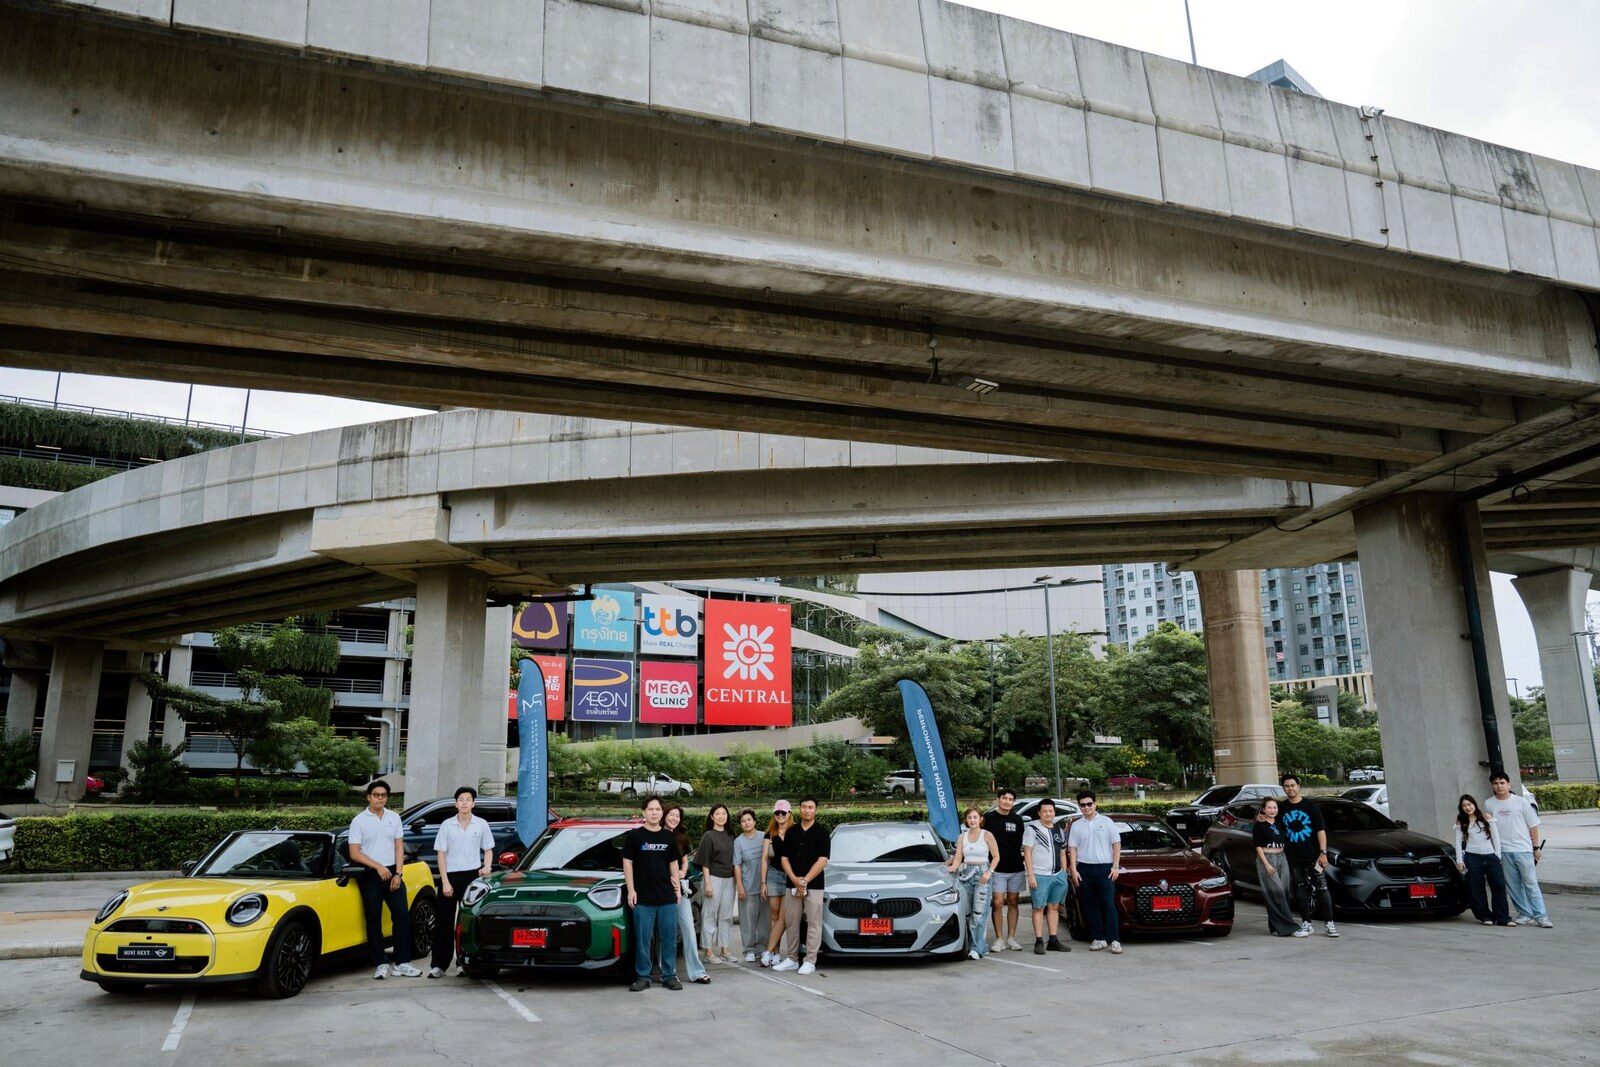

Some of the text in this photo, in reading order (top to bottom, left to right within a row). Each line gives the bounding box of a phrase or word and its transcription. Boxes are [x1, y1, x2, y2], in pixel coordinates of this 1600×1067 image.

[644, 606, 697, 638] ttb
[581, 627, 628, 643] กรุงไทย
[648, 683, 690, 695] MEGA
[706, 688, 790, 704] CENTRAL
[652, 697, 686, 706] CLINIC
